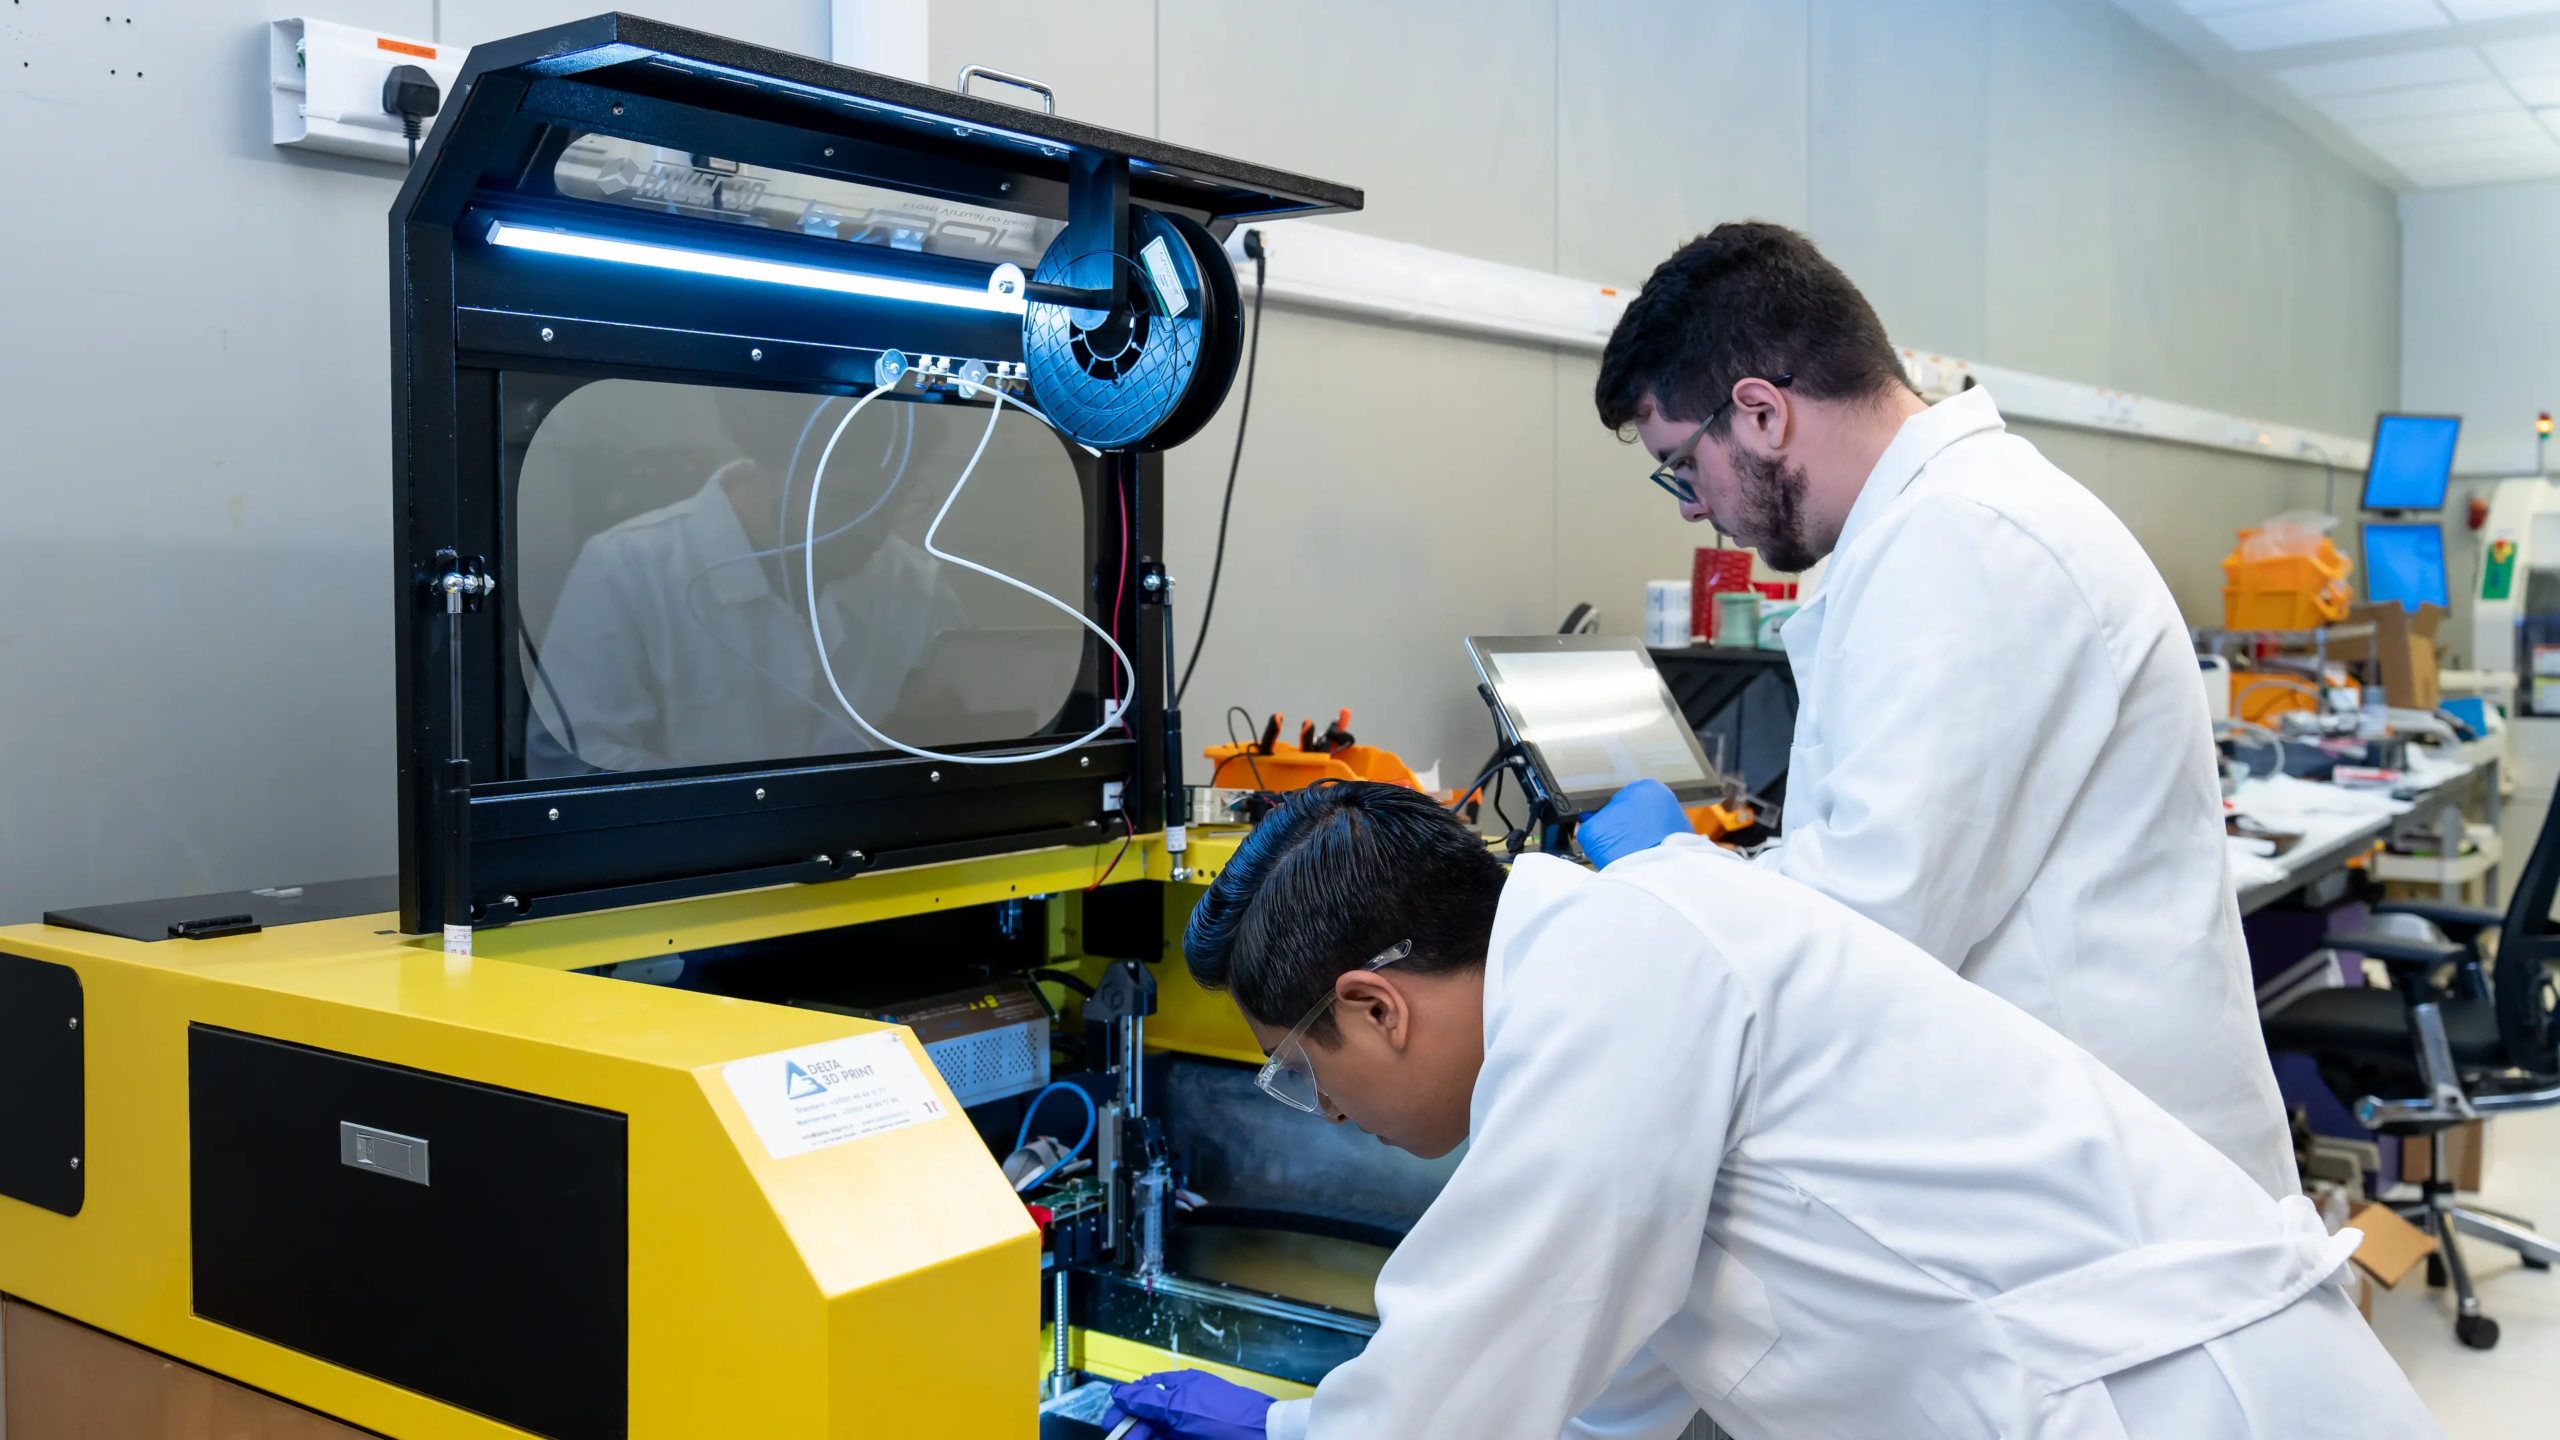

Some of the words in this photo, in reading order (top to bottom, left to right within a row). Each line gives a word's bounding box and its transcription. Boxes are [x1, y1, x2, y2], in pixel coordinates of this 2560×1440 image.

[807, 1059, 843, 1075] DELTA
[822, 1073, 841, 1086] 3D
[841, 1064, 875, 1082] PRINT
